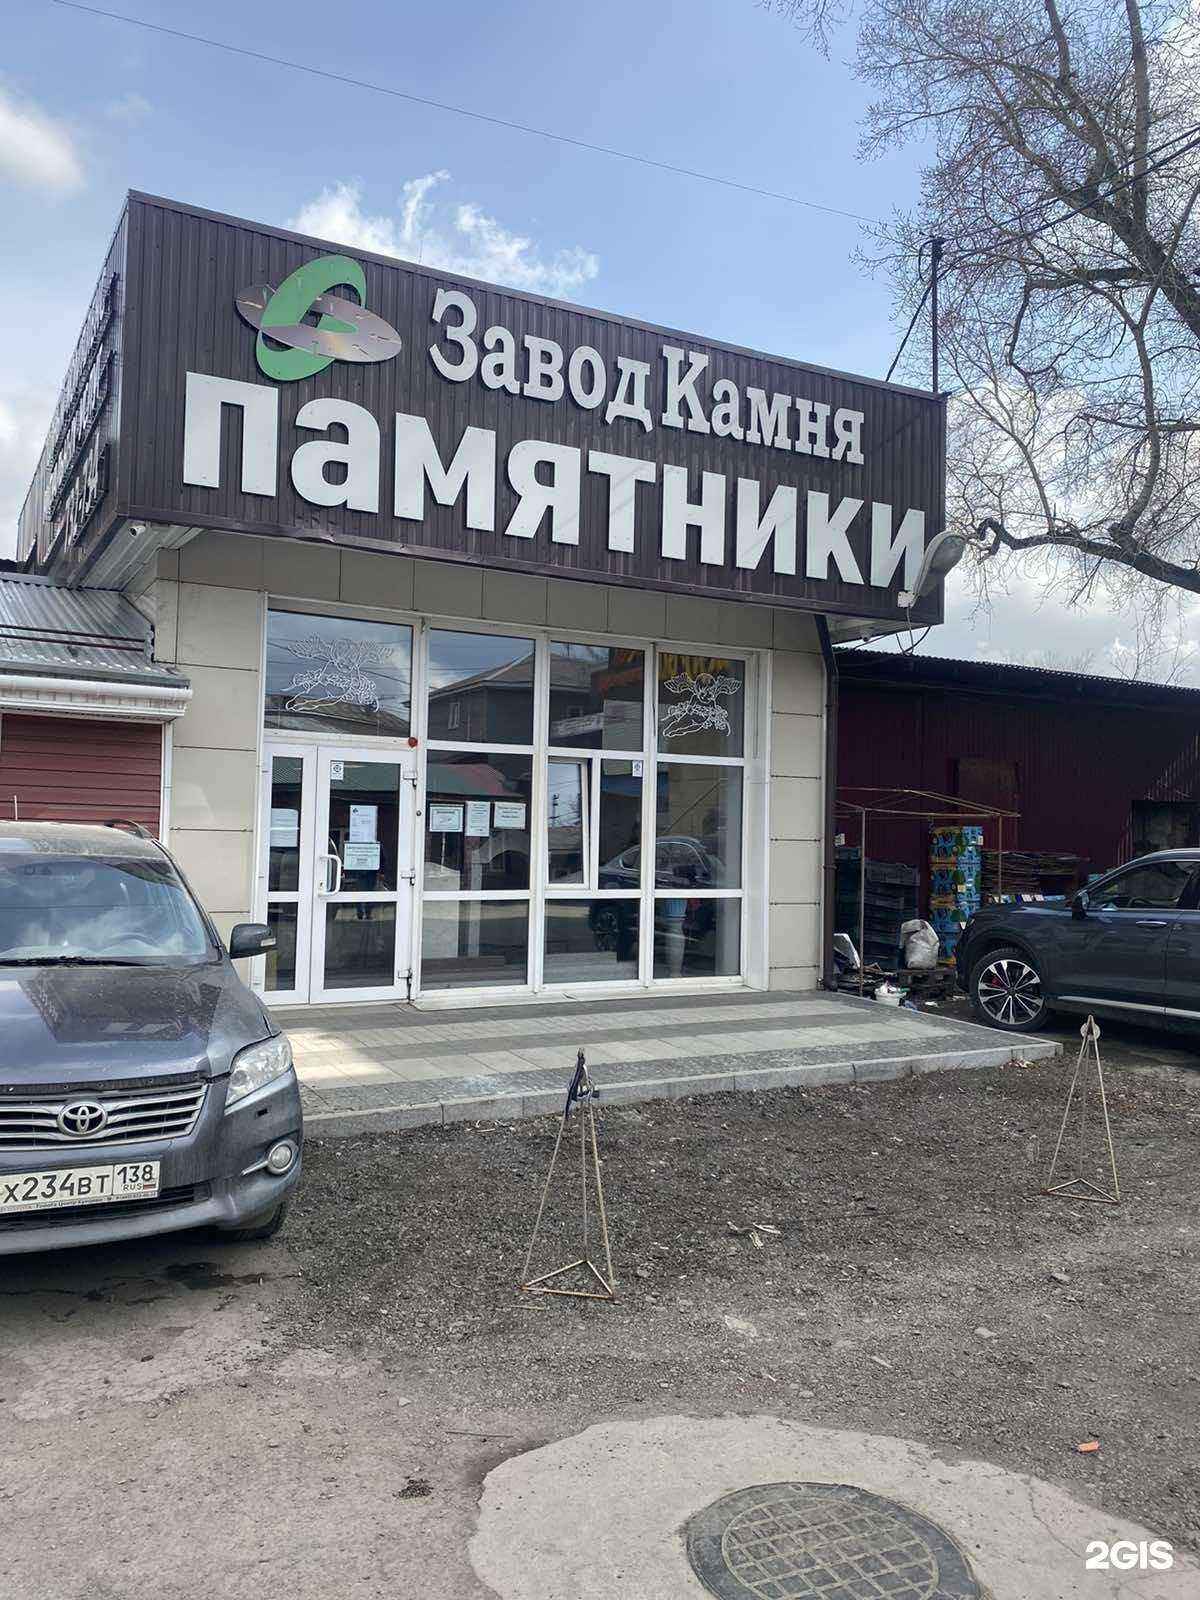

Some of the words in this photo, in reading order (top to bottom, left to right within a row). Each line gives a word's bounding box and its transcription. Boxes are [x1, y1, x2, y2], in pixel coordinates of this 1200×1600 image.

[430, 287, 654, 433] Завод
[661, 344, 865, 465] Камня
[117, 1164, 154, 1184] 138
[122, 1181, 143, 1192] RUS
